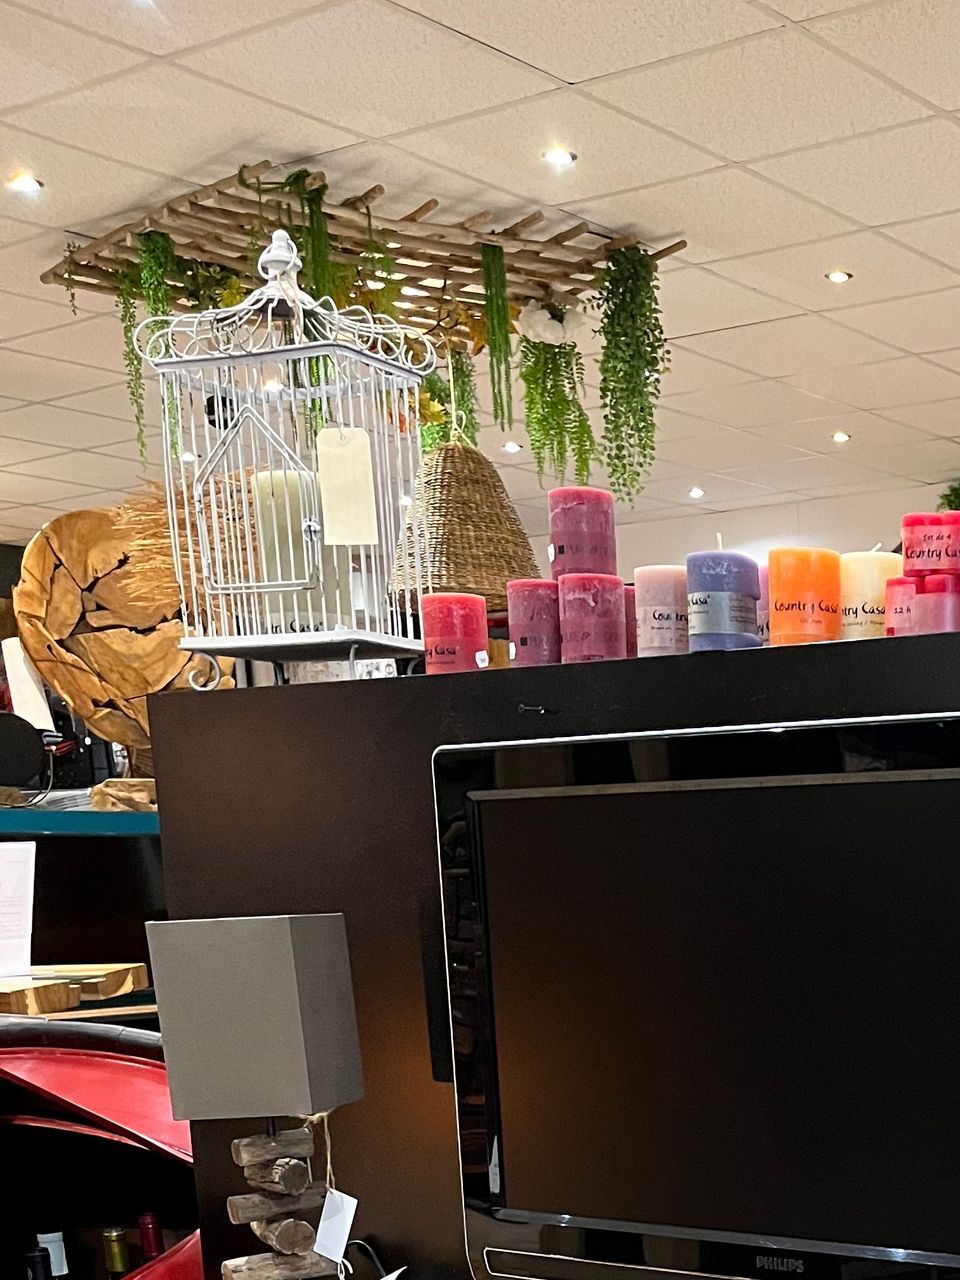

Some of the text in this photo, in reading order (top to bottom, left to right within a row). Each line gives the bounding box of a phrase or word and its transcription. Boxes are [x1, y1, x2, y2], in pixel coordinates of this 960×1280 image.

[905, 547, 942, 561] Country
[774, 600, 815, 614] Country
[861, 601, 886, 615] Casa
[652, 609, 688, 624] Coutry
[756, 1255, 805, 1273] PHILIPS
